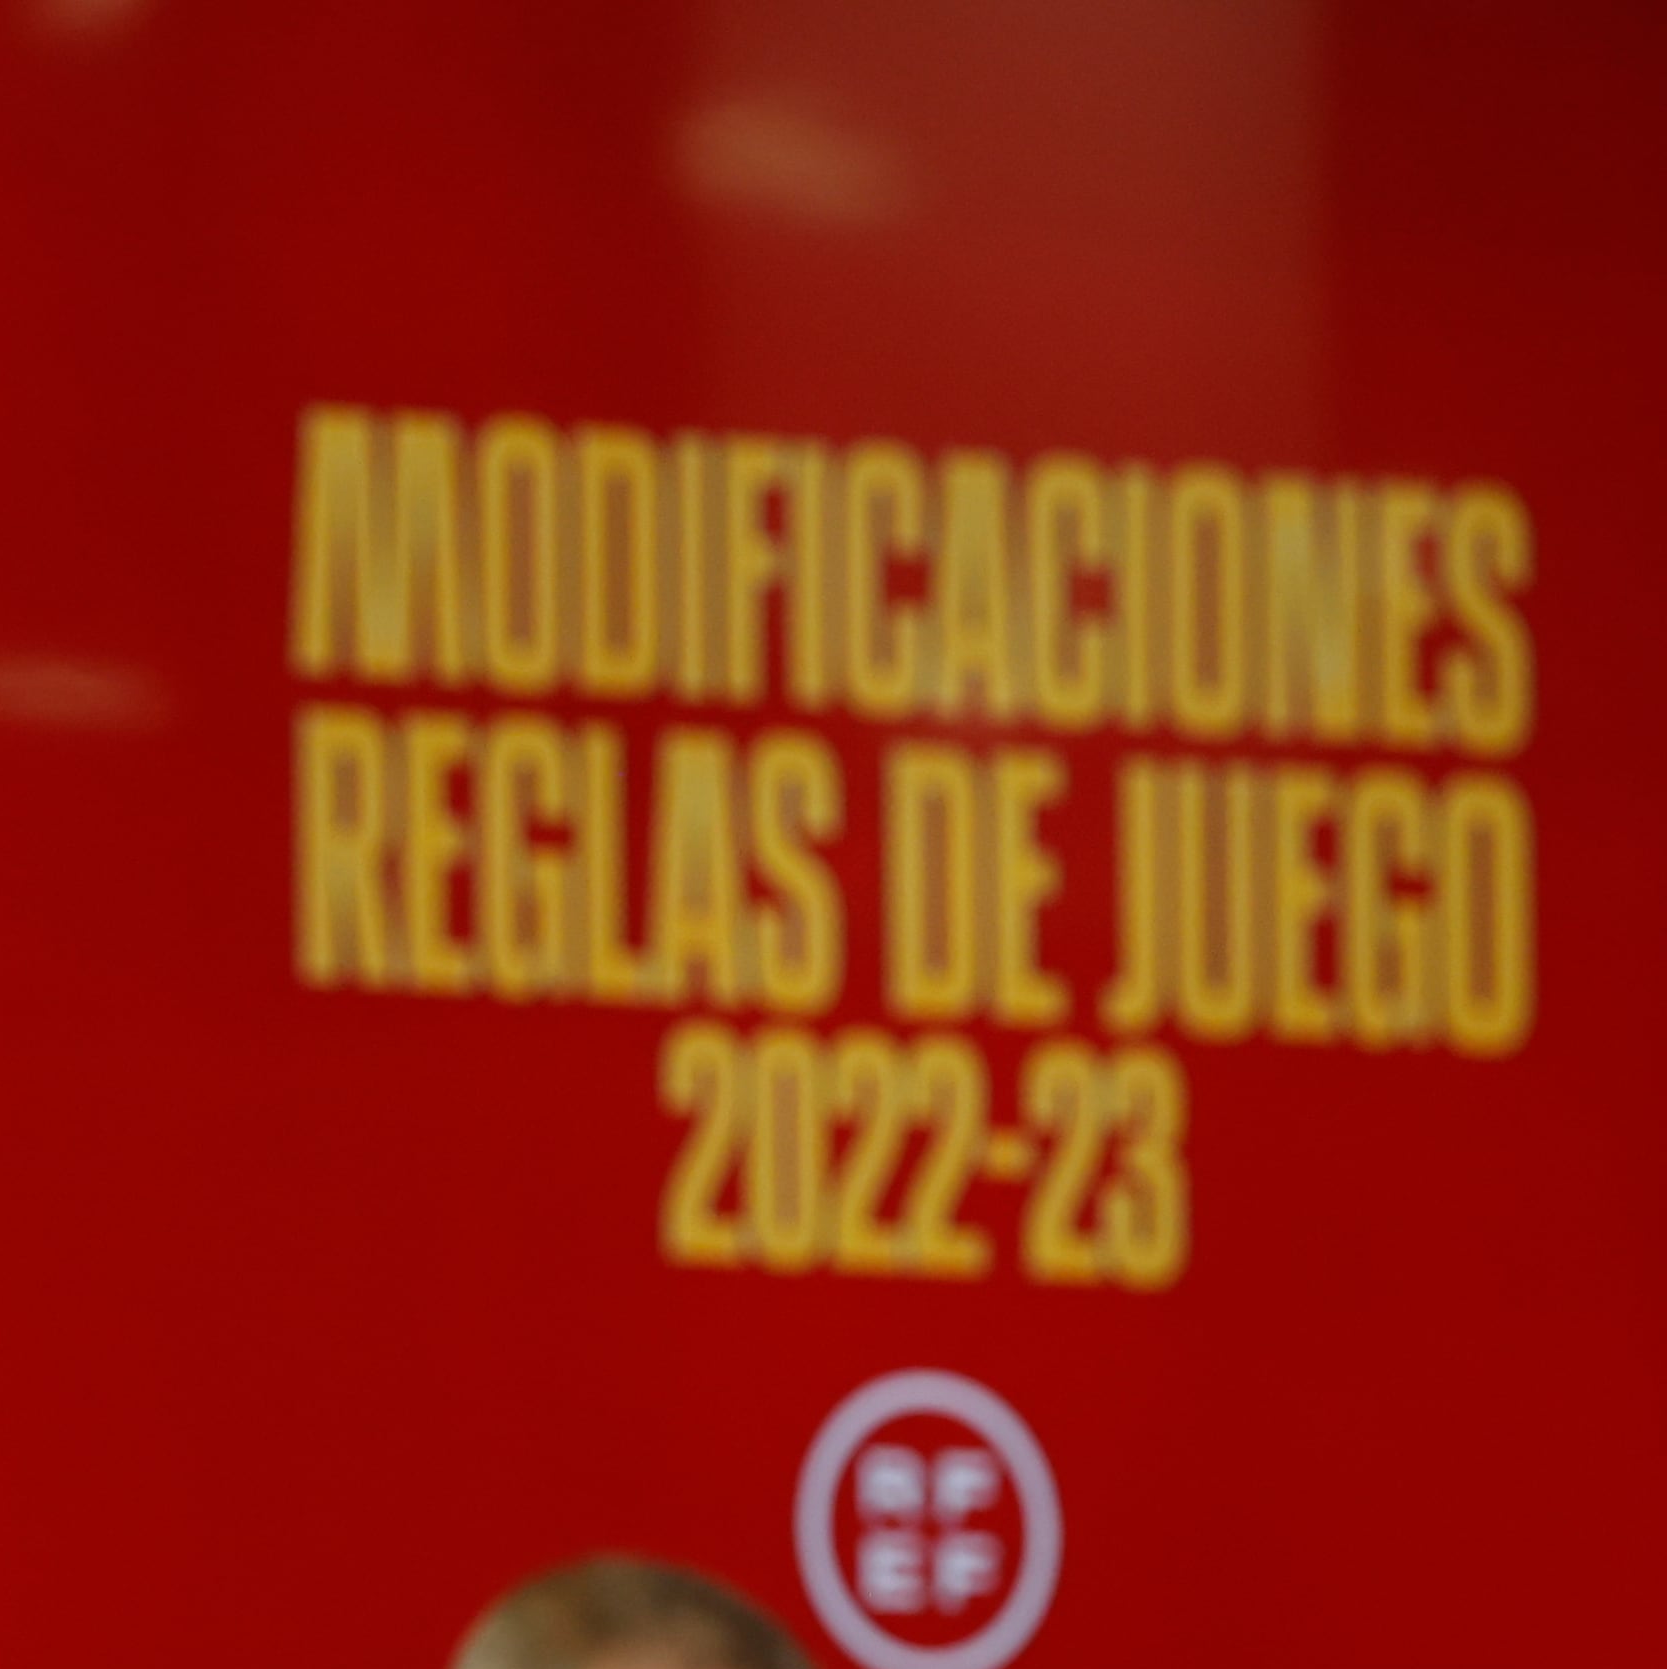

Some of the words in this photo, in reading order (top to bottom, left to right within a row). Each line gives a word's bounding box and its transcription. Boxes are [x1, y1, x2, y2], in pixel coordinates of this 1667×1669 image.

[290, 402, 1535, 758] MODIFICACIONES
[293, 698, 849, 1016] REGLAS
[877, 738, 1073, 1026] DE
[1099, 748, 1537, 1060] JUEGO
[657, 1018, 1191, 1294] 2022-23
[854, 1443, 1003, 1525] RF
[855, 1529, 1007, 1616] EF
